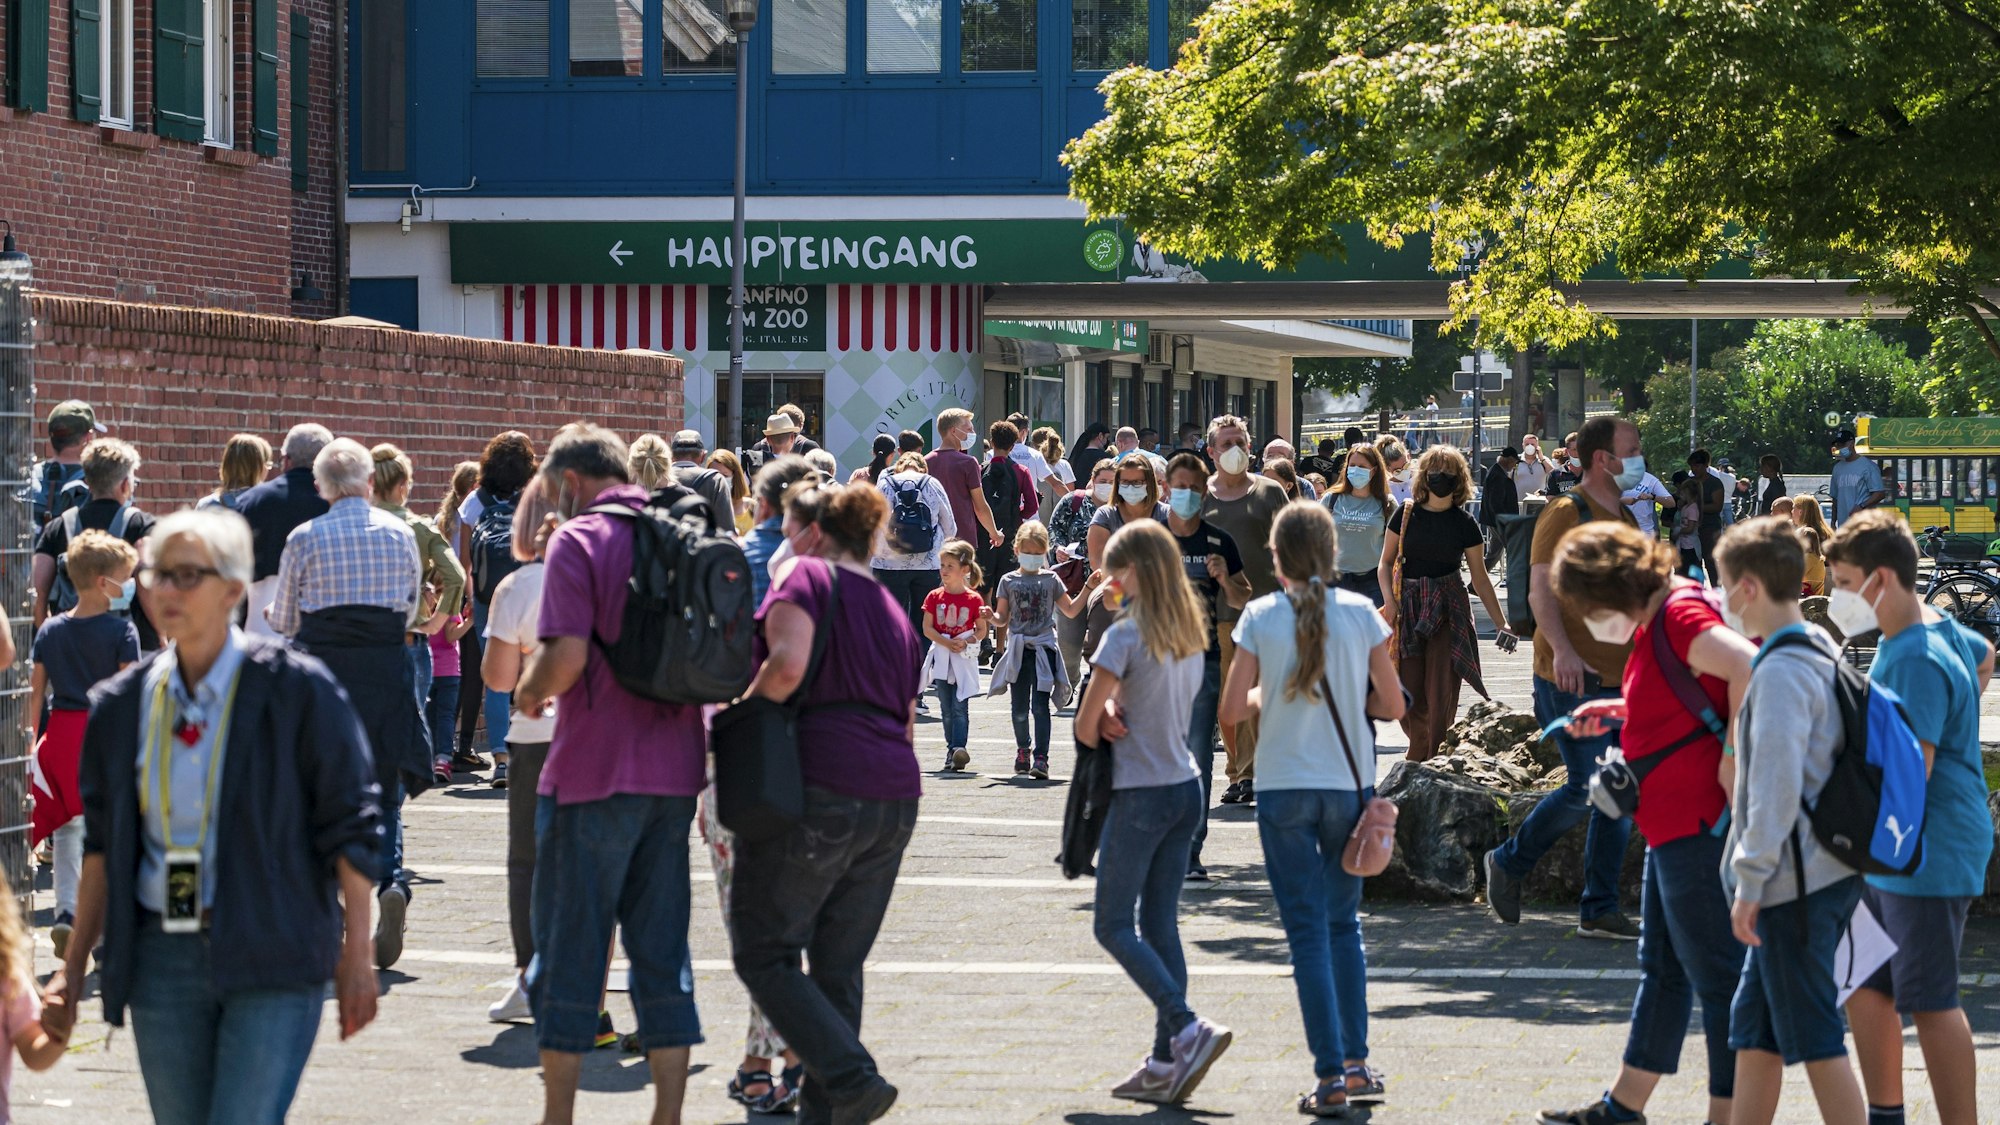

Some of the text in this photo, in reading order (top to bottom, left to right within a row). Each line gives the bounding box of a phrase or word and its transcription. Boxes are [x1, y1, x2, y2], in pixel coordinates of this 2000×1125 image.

[668, 235, 978, 270] HAUPTEINGANG
[763, 308, 809, 329] ZOO
[760, 335, 787, 344] ITAL.
[791, 335, 809, 344] EIS
[1829, 415, 1837, 424] H
